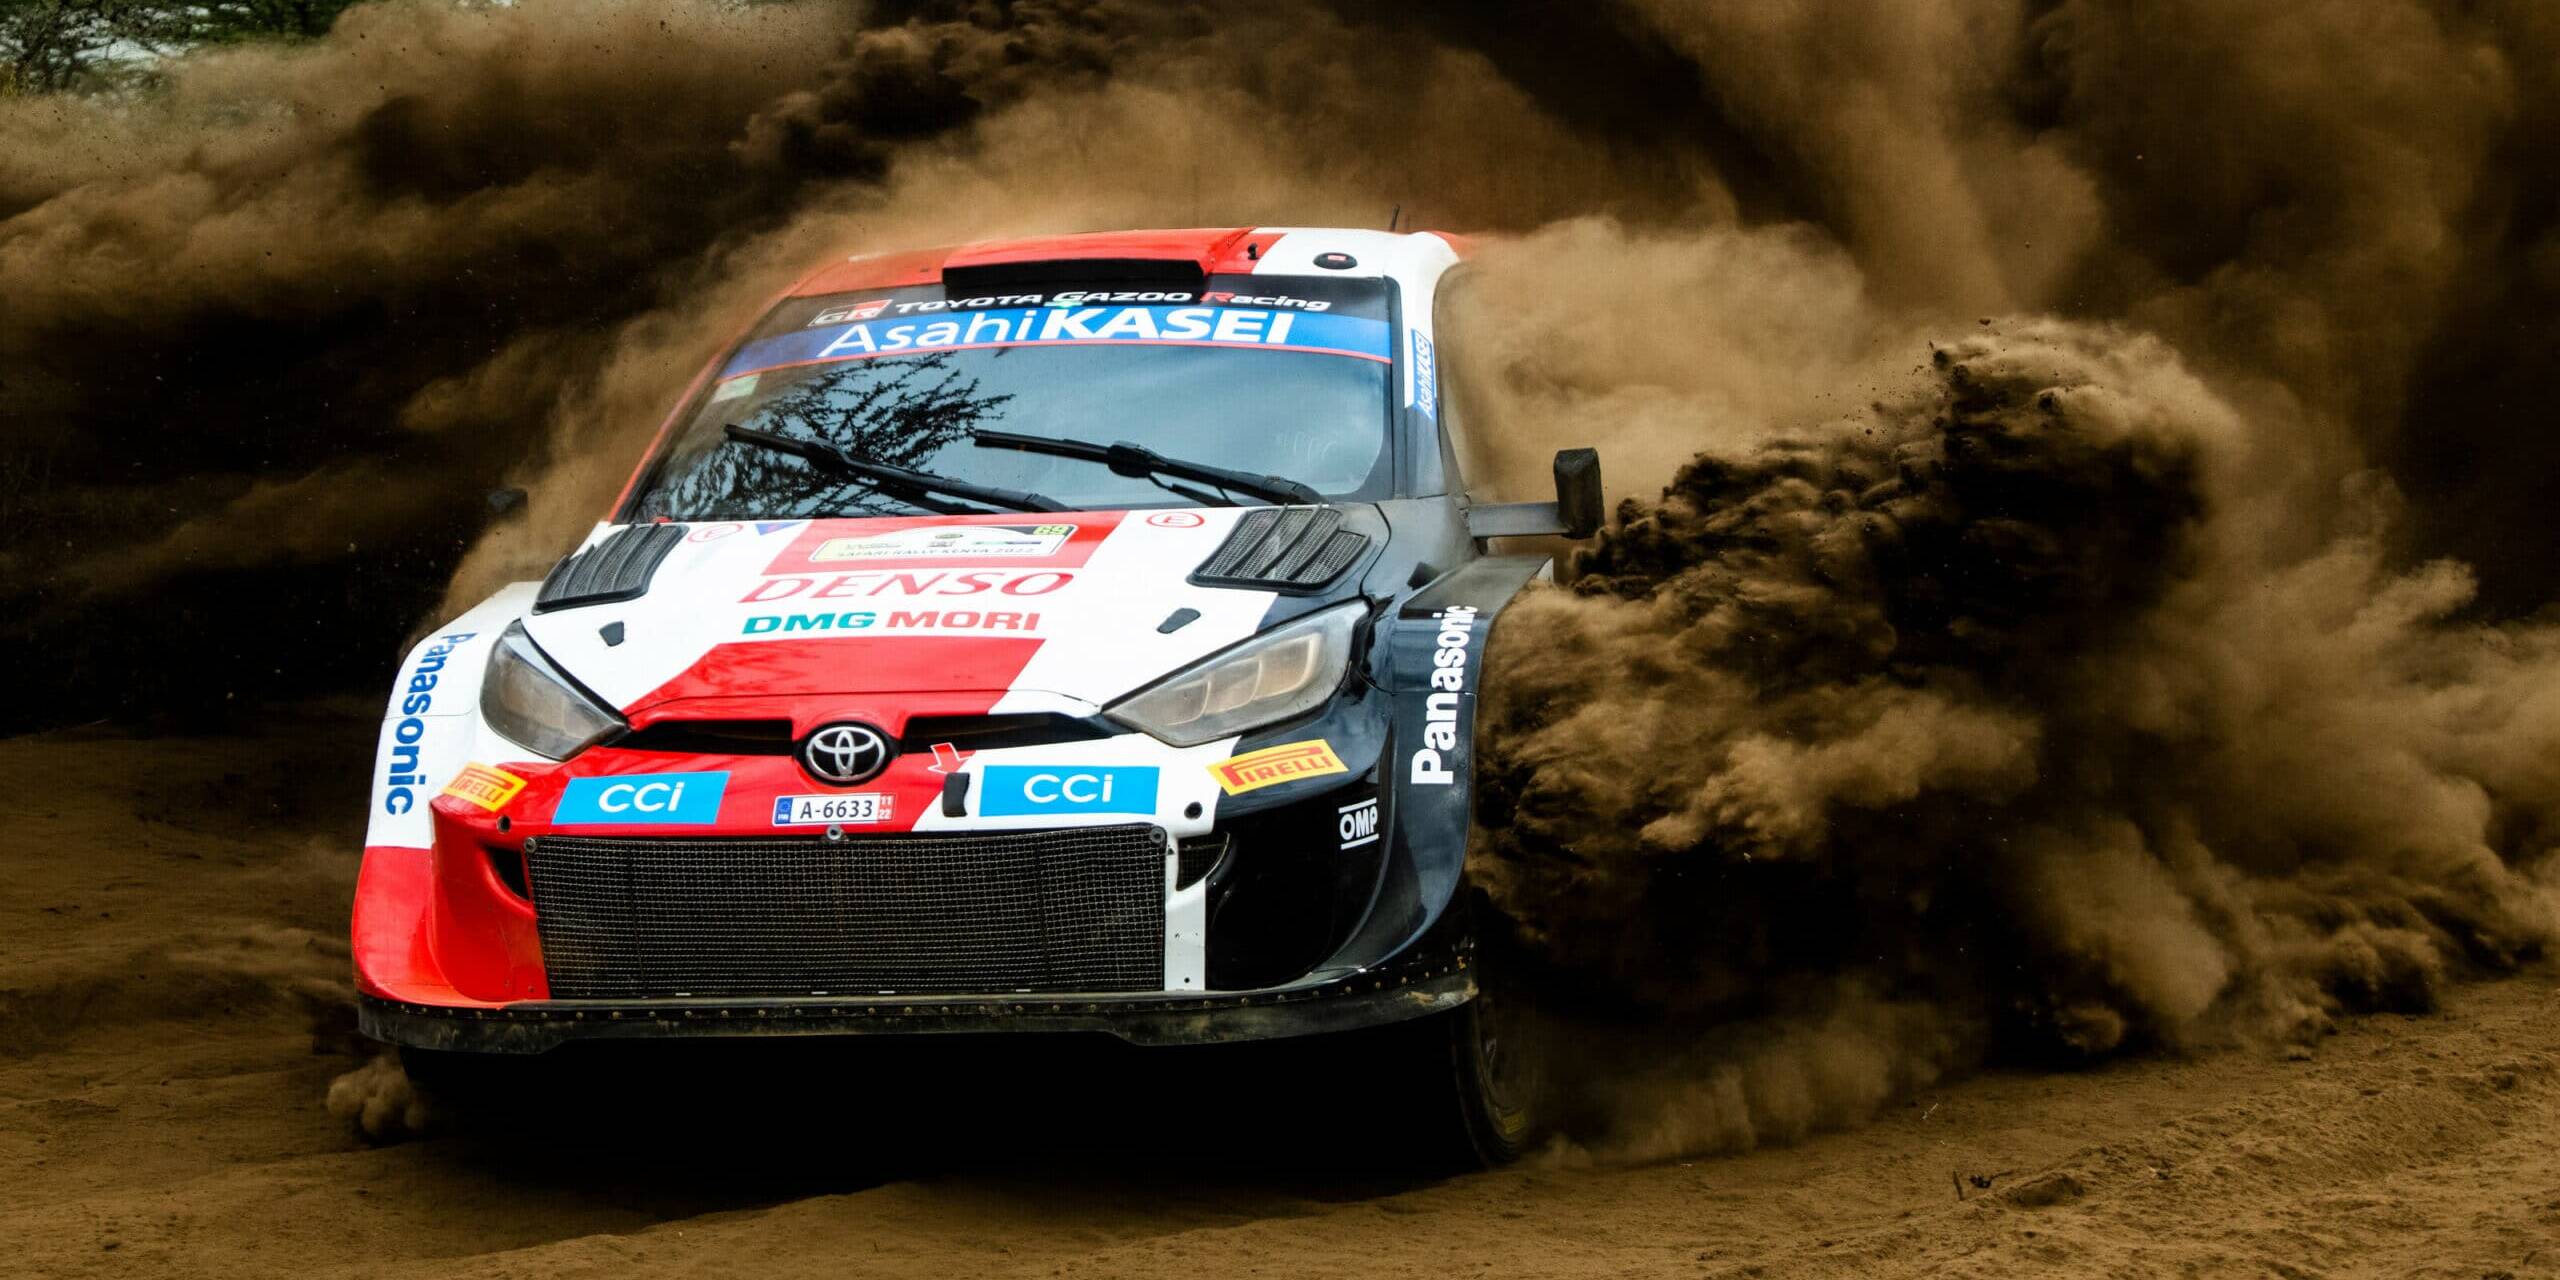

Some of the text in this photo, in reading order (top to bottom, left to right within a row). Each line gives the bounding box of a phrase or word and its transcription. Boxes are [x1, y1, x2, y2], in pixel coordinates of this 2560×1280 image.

[896, 291, 1332, 314] TOYOTA GAZOO Racing
[737, 571, 1075, 604] DENSO
[740, 610, 1041, 635] DMG MORI
[1411, 604, 1478, 785] Panasonic
[385, 632, 477, 816] Panasonic
[1220, 746, 1334, 787] PIRELLI
[447, 767, 515, 803] PIRELLI
[800, 799, 873, 819] A-6633
[1339, 805, 1379, 841] OMP
